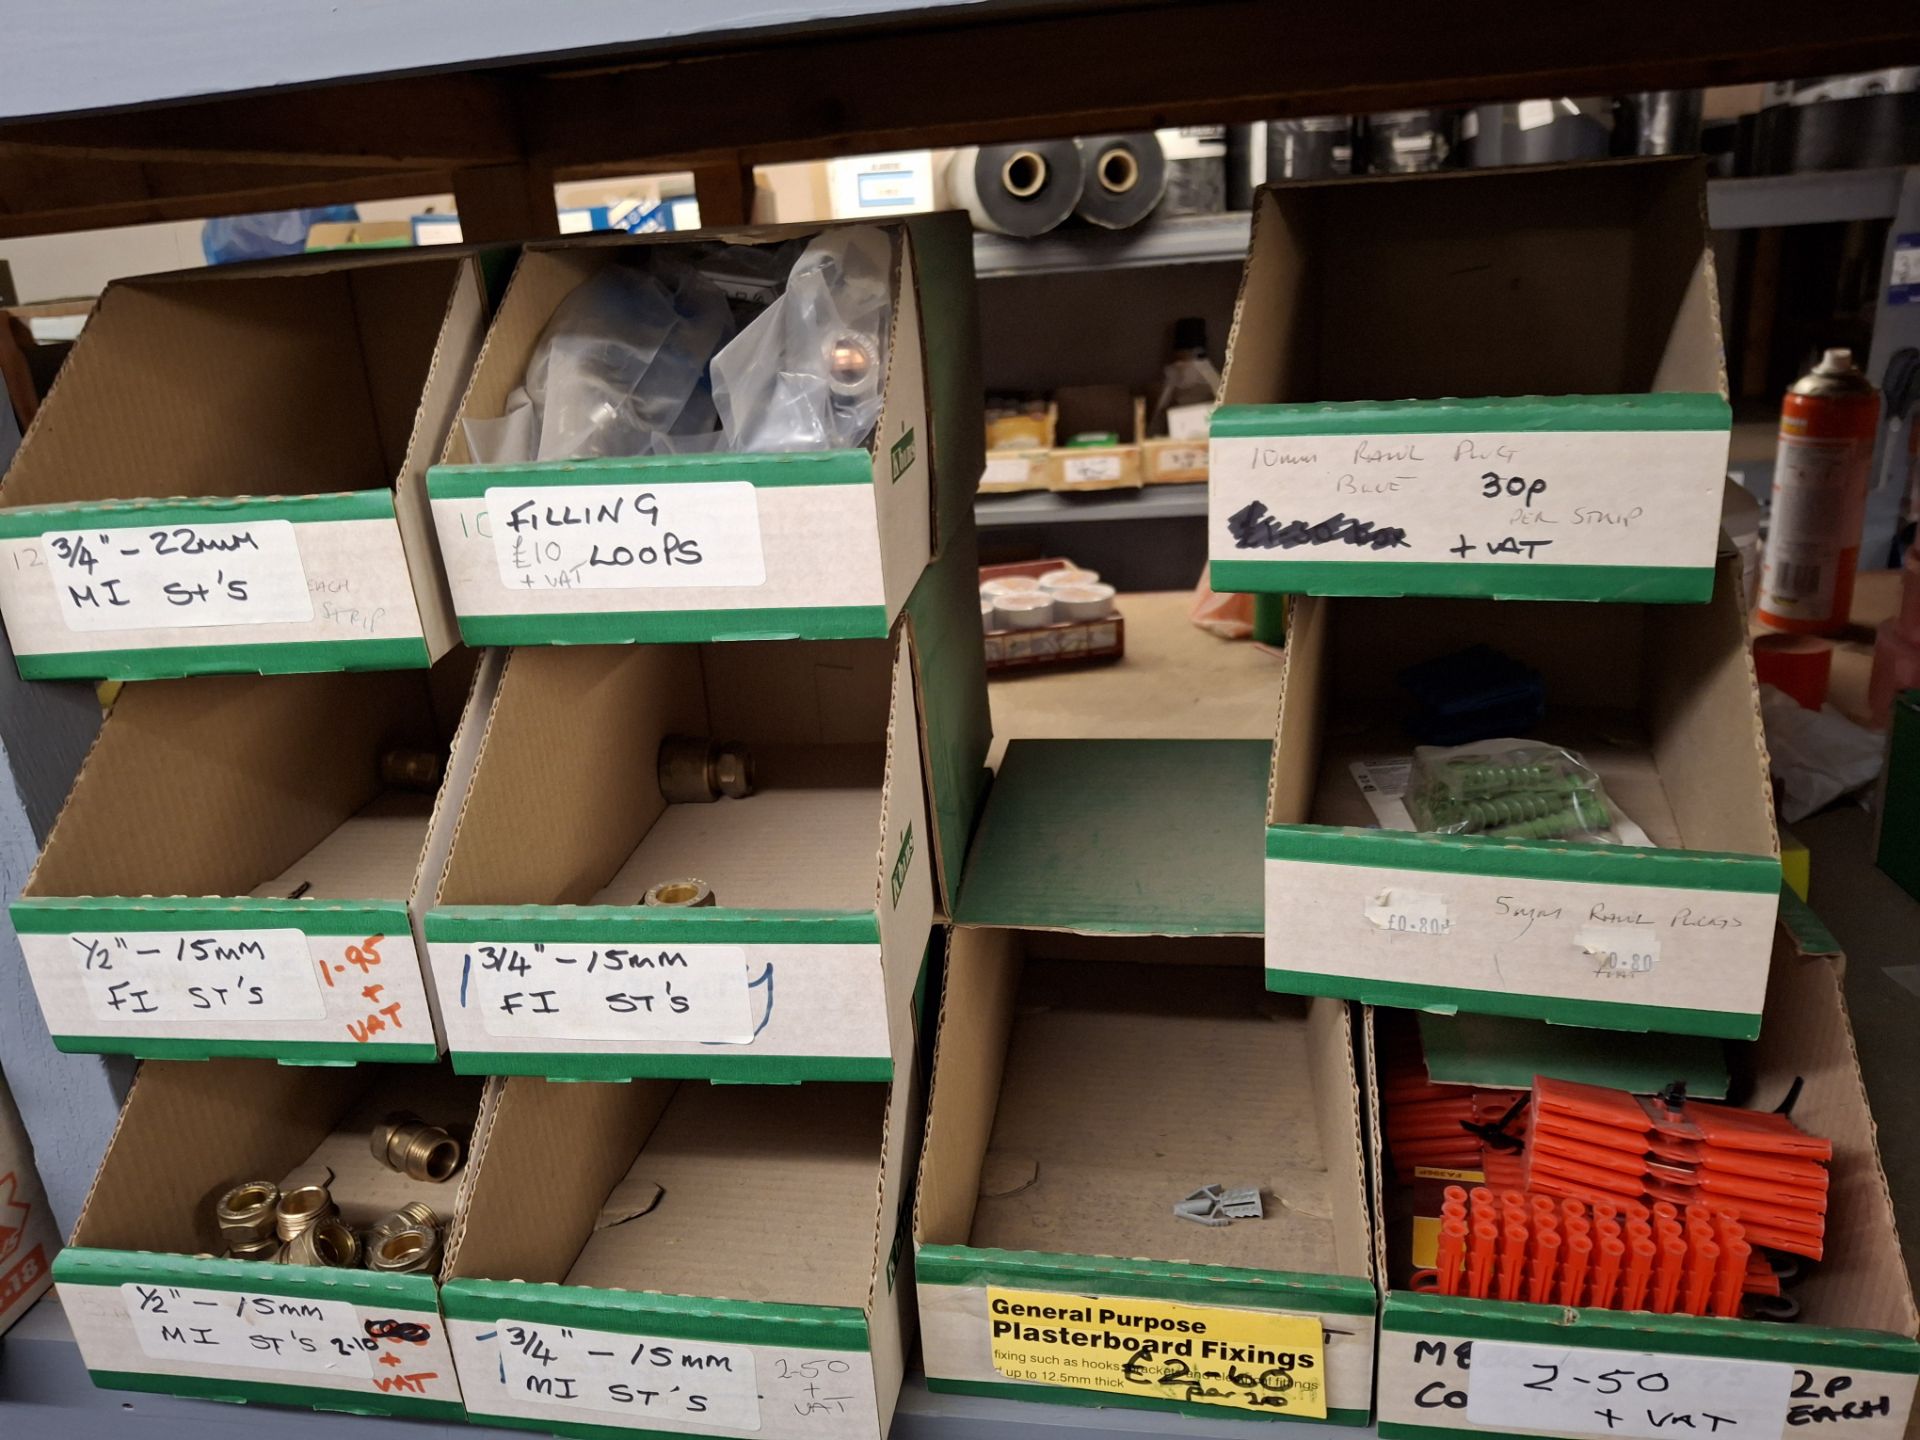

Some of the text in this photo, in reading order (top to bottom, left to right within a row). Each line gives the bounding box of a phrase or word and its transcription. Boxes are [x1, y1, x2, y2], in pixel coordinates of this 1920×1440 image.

[992, 1298, 1207, 1334] General Purpose
[993, 1320, 1315, 1370] Plasterboard Fixings
[994, 1349, 1026, 1364] fixing
[1030, 1353, 1060, 1366] such
[1063, 1358, 1078, 1368] as
[1006, 1369, 1124, 1388] up to 12.5mm thick
